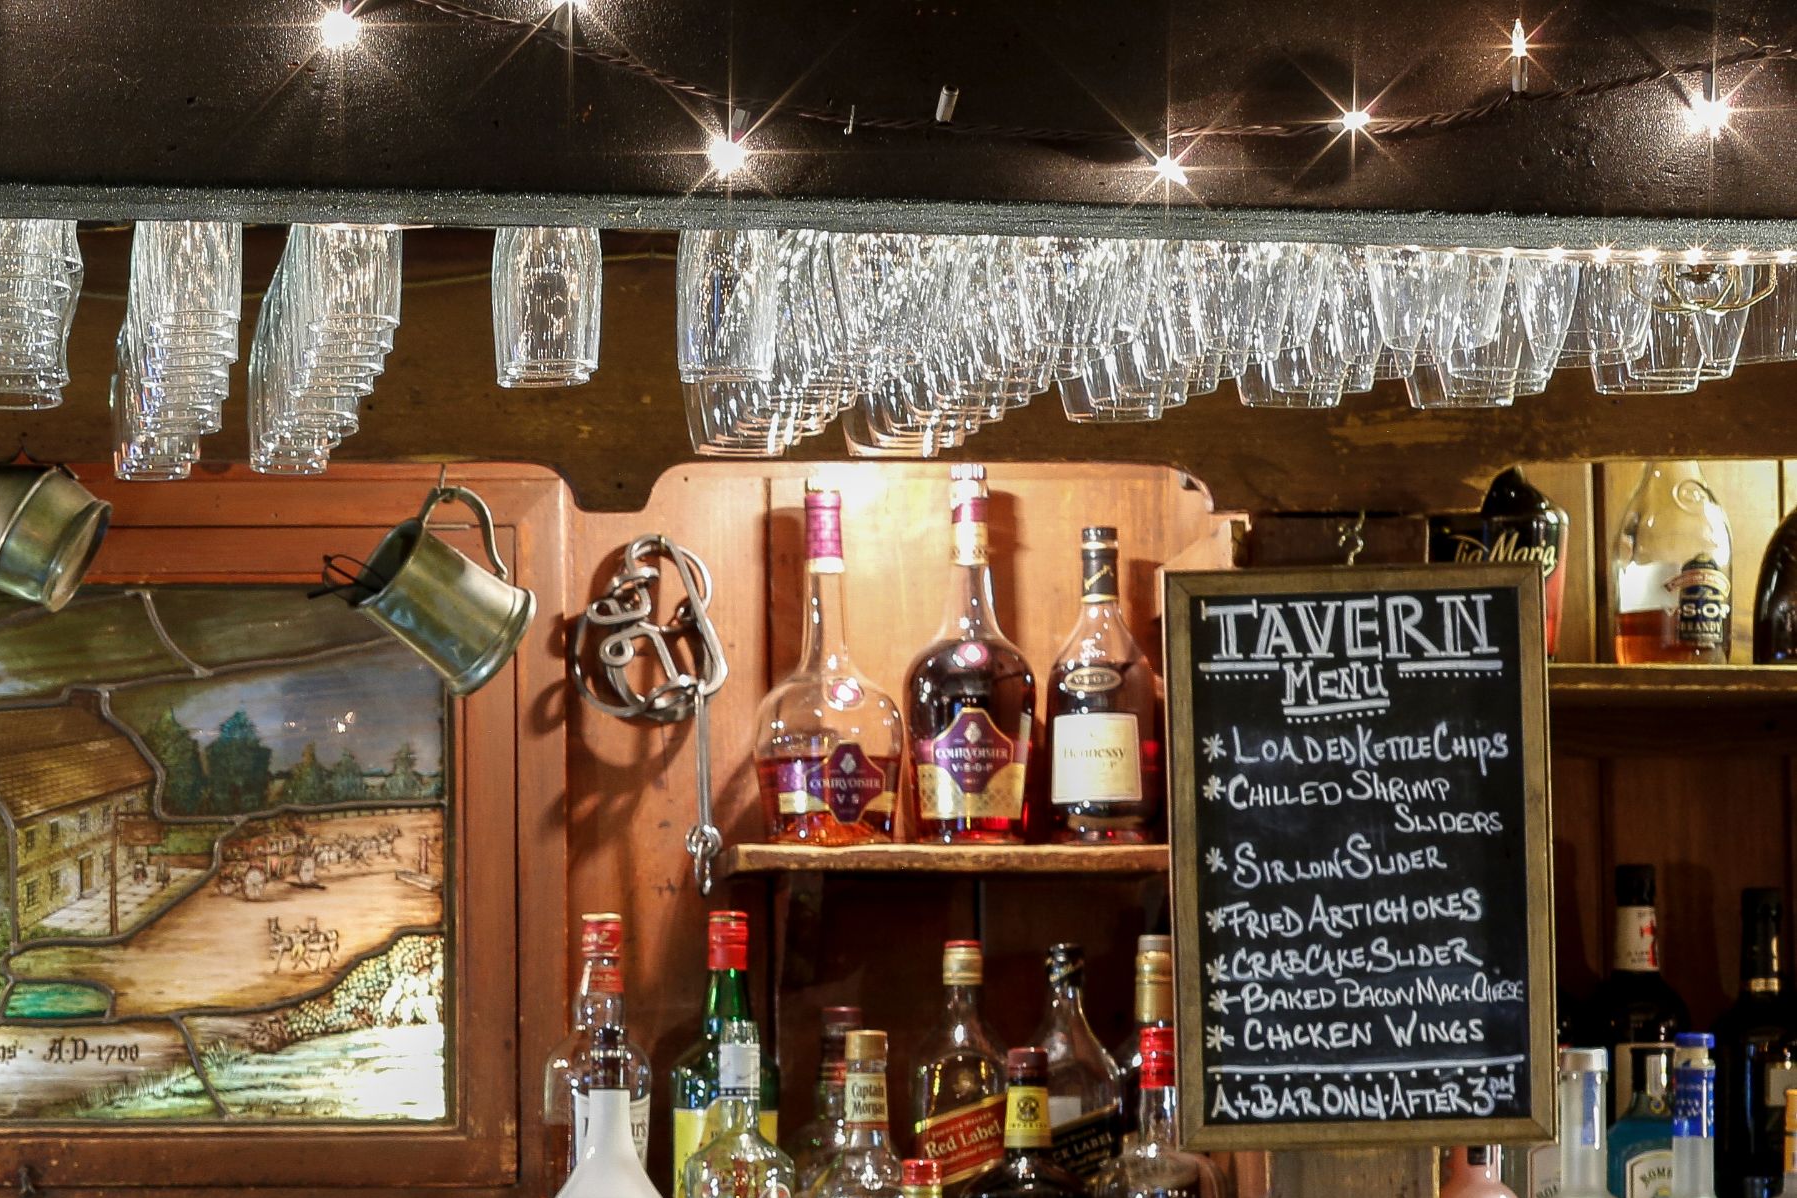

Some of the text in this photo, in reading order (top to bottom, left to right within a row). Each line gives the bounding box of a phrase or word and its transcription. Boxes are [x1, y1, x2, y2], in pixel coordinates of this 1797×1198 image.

[1489, 530, 1556, 577] Maria
[1201, 594, 1499, 660] TAVERN
[1281, 660, 1389, 705] MENU
[934, 747, 1009, 761] COURVOISIER
[1227, 769, 1450, 810] CHILLED SHRIMP
[1394, 803, 1503, 834] SLIDERS
[1223, 887, 1482, 939] FRIED ARTICHOKES
[1240, 982, 1337, 1014] BAKED
[1335, 978, 1415, 1009] BACON
[1244, 1010, 1484, 1051] CHICKEN WINGS
[851, 1083, 885, 1101] Captain
[925, 1119, 1002, 1158] Red Label
[1640, 1166, 1674, 1187] BOM
